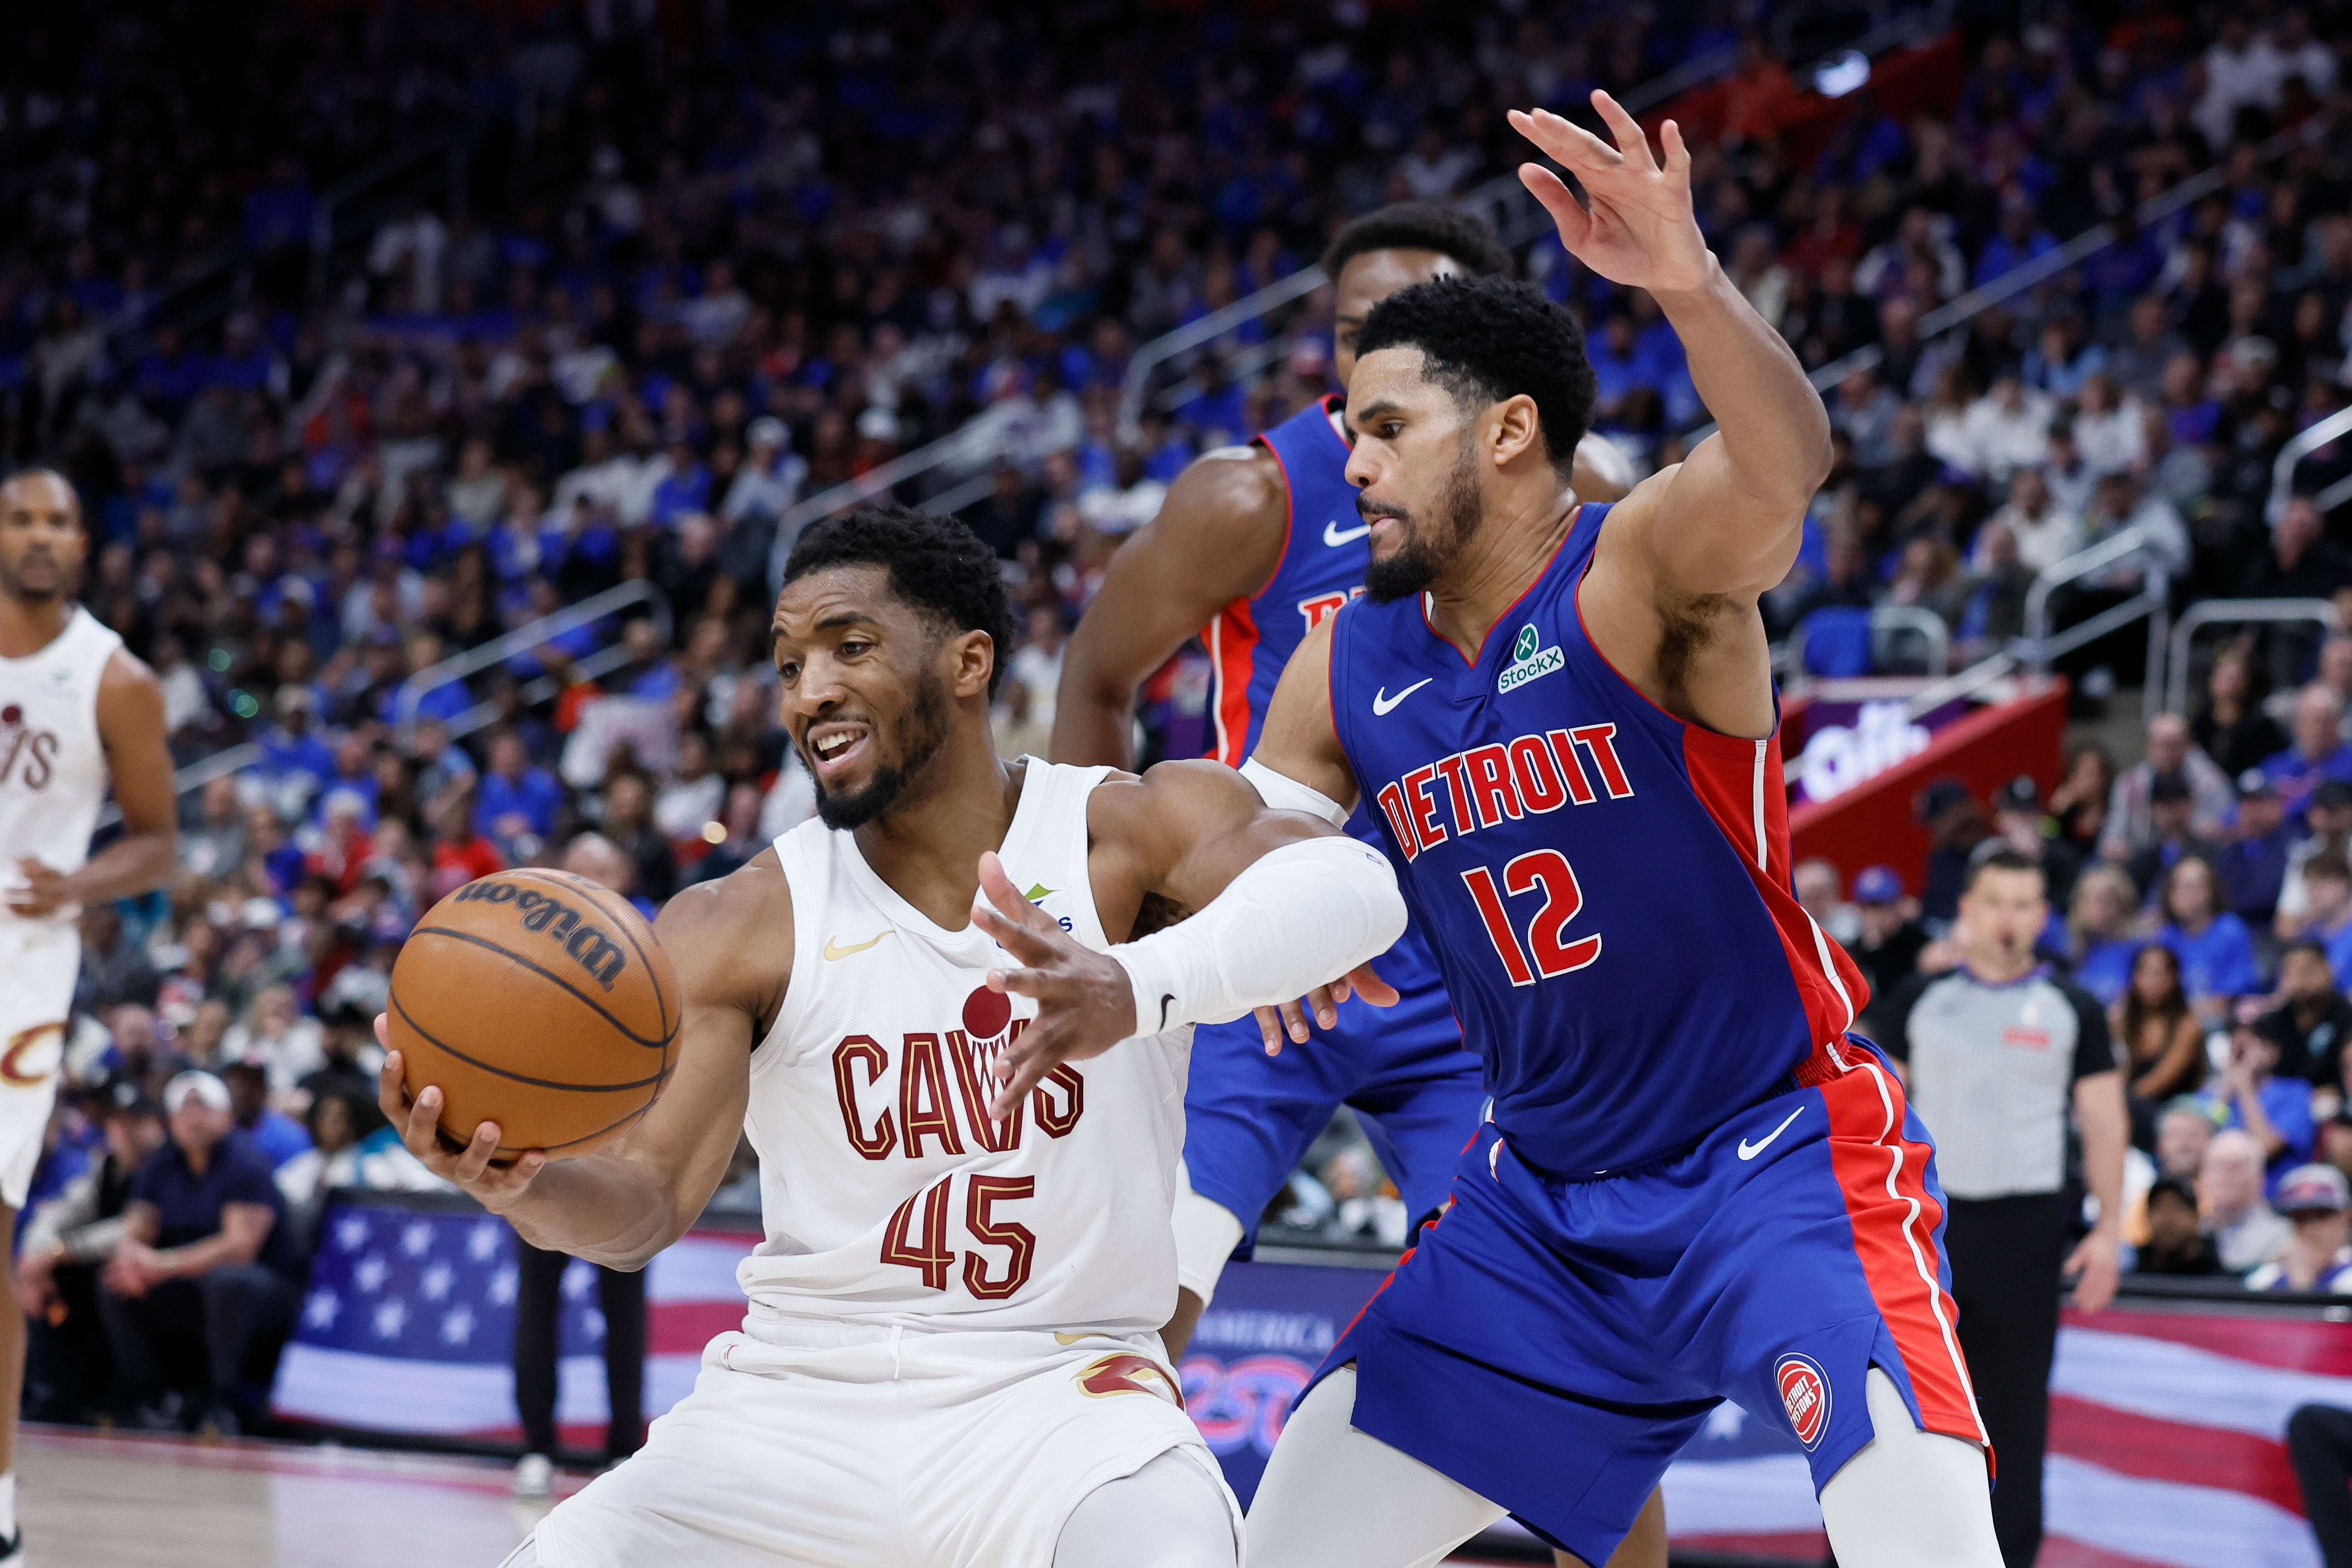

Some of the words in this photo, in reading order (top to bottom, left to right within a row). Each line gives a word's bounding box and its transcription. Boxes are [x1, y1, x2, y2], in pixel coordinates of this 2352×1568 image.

[1500, 648, 1562, 691] StockX
[1377, 722, 1635, 864] DETROIT
[455, 880, 627, 993] Wilson
[1460, 849, 1602, 987] 12
[880, 1173, 1036, 1300] 45
[1785, 1375, 1810, 1415] DETROIT
[1792, 1387, 1817, 1428] PISTONS
